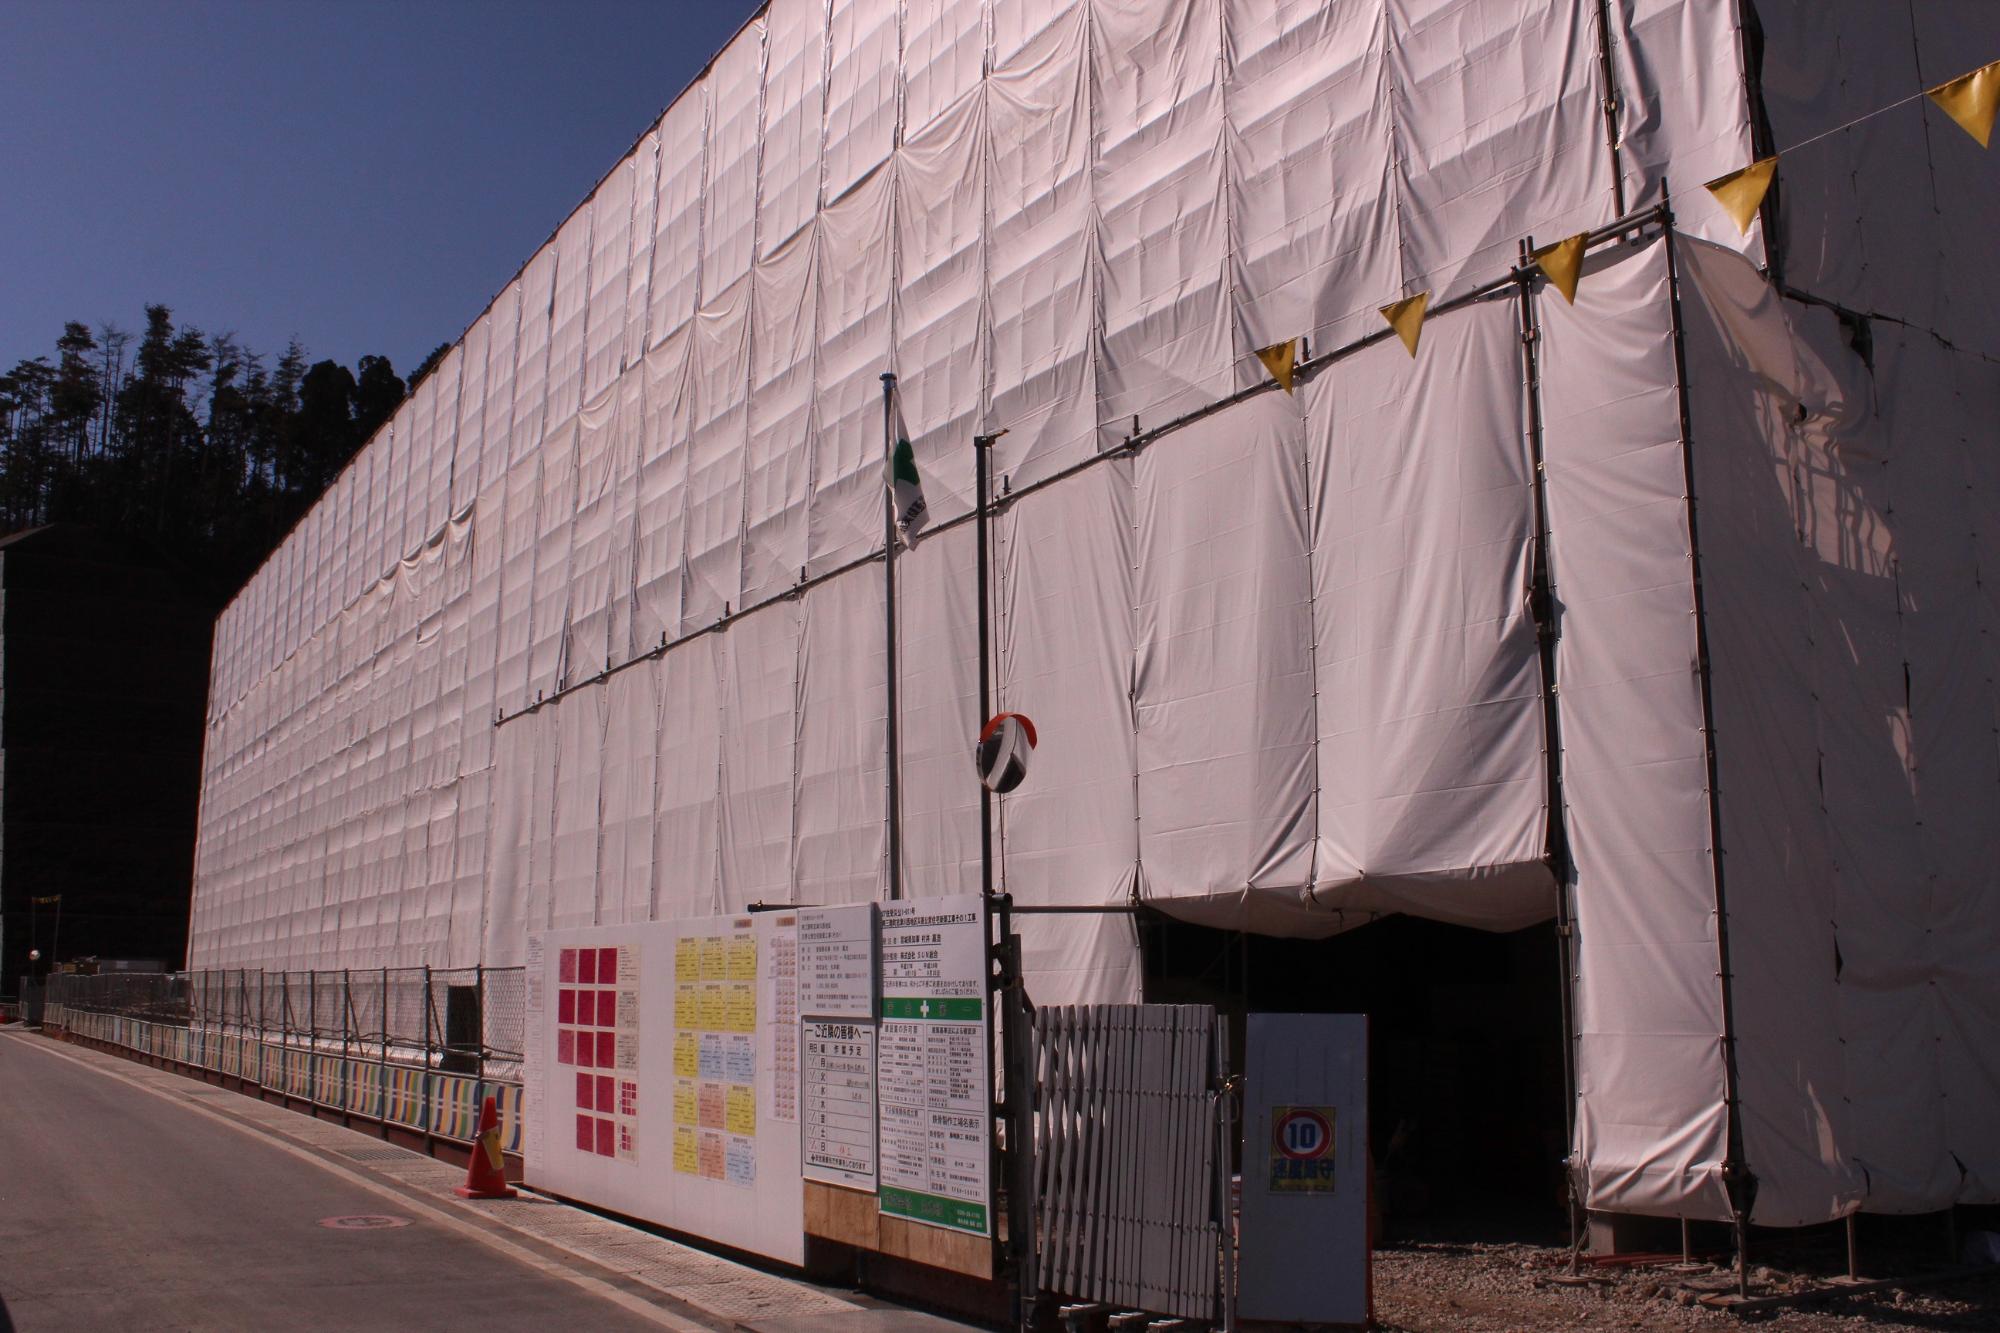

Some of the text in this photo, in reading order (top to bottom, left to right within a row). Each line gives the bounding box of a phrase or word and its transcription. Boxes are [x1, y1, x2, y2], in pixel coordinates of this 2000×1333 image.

[815, 1024, 861, 1040] ご近隣の皆様へ
[932, 1114, 979, 1128] 鉄骨製作工場名表示
[1288, 1122, 1316, 1150] 10
